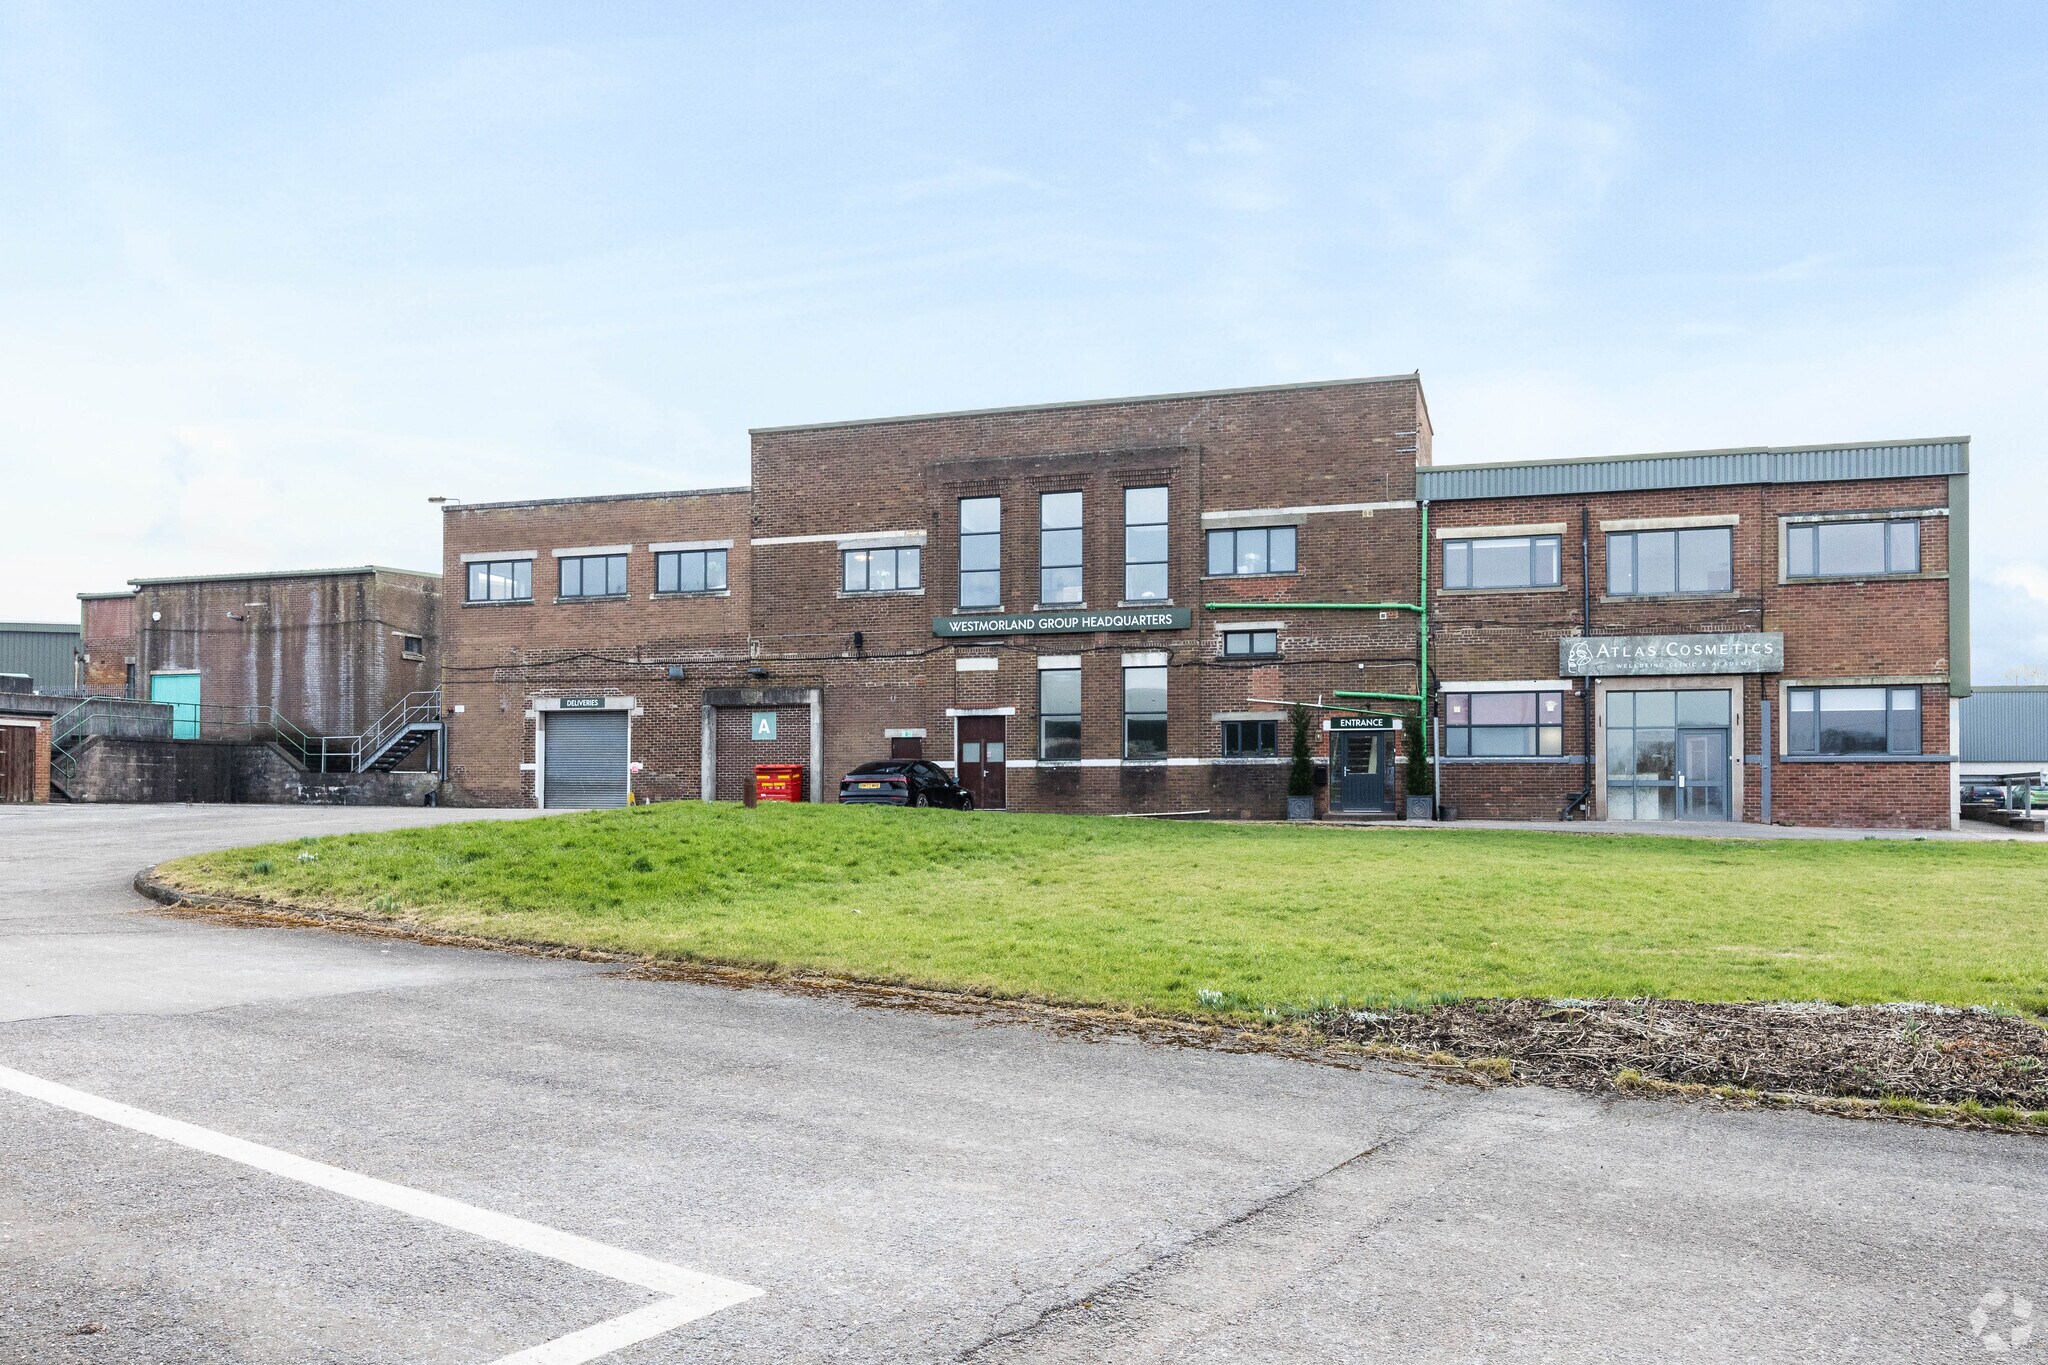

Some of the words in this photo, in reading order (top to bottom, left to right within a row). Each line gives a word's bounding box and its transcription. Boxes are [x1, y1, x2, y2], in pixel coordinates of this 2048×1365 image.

[949, 618, 1035, 632] WESTMORLAND
[1038, 617, 1079, 630] GROUP
[1082, 614, 1173, 628] HEADQUARTERS
[1597, 643, 1657, 658] ATLAS
[566, 699, 599, 707] DELIVERIES
[758, 718, 771, 734] A
[1340, 718, 1384, 727] ENTRANCE
